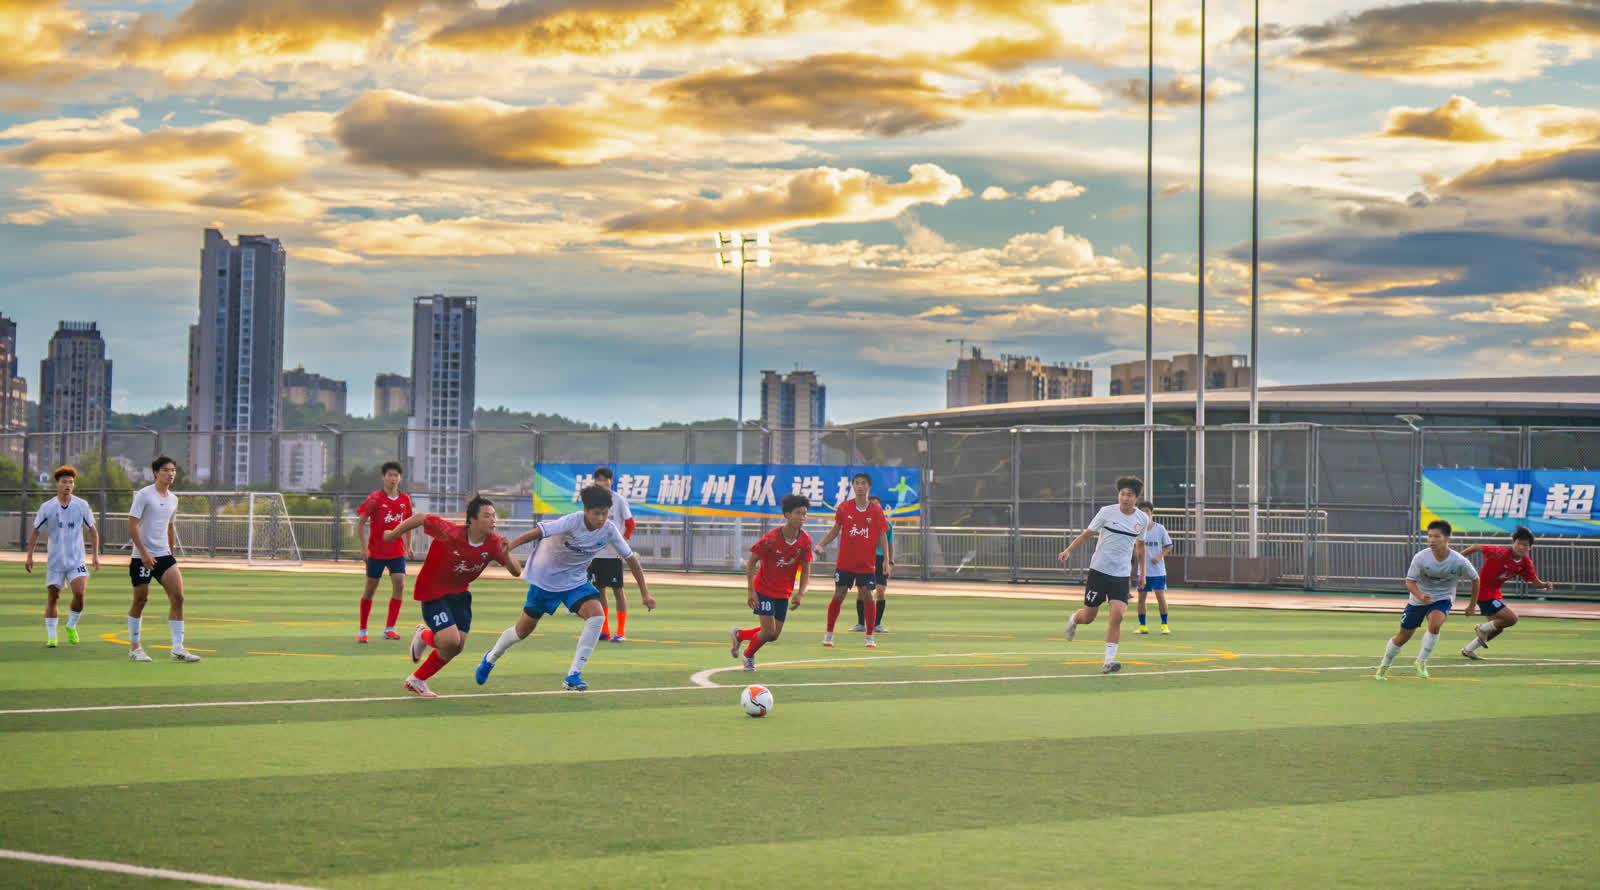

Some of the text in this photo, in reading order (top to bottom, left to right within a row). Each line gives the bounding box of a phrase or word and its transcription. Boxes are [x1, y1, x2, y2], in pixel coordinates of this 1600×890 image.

[1479, 482, 1595, 520] 湘超
[849, 524, 869, 539] 永州
[139, 566, 151, 577] 33
[761, 601, 771, 612] 10
[433, 611, 449, 626] 20
